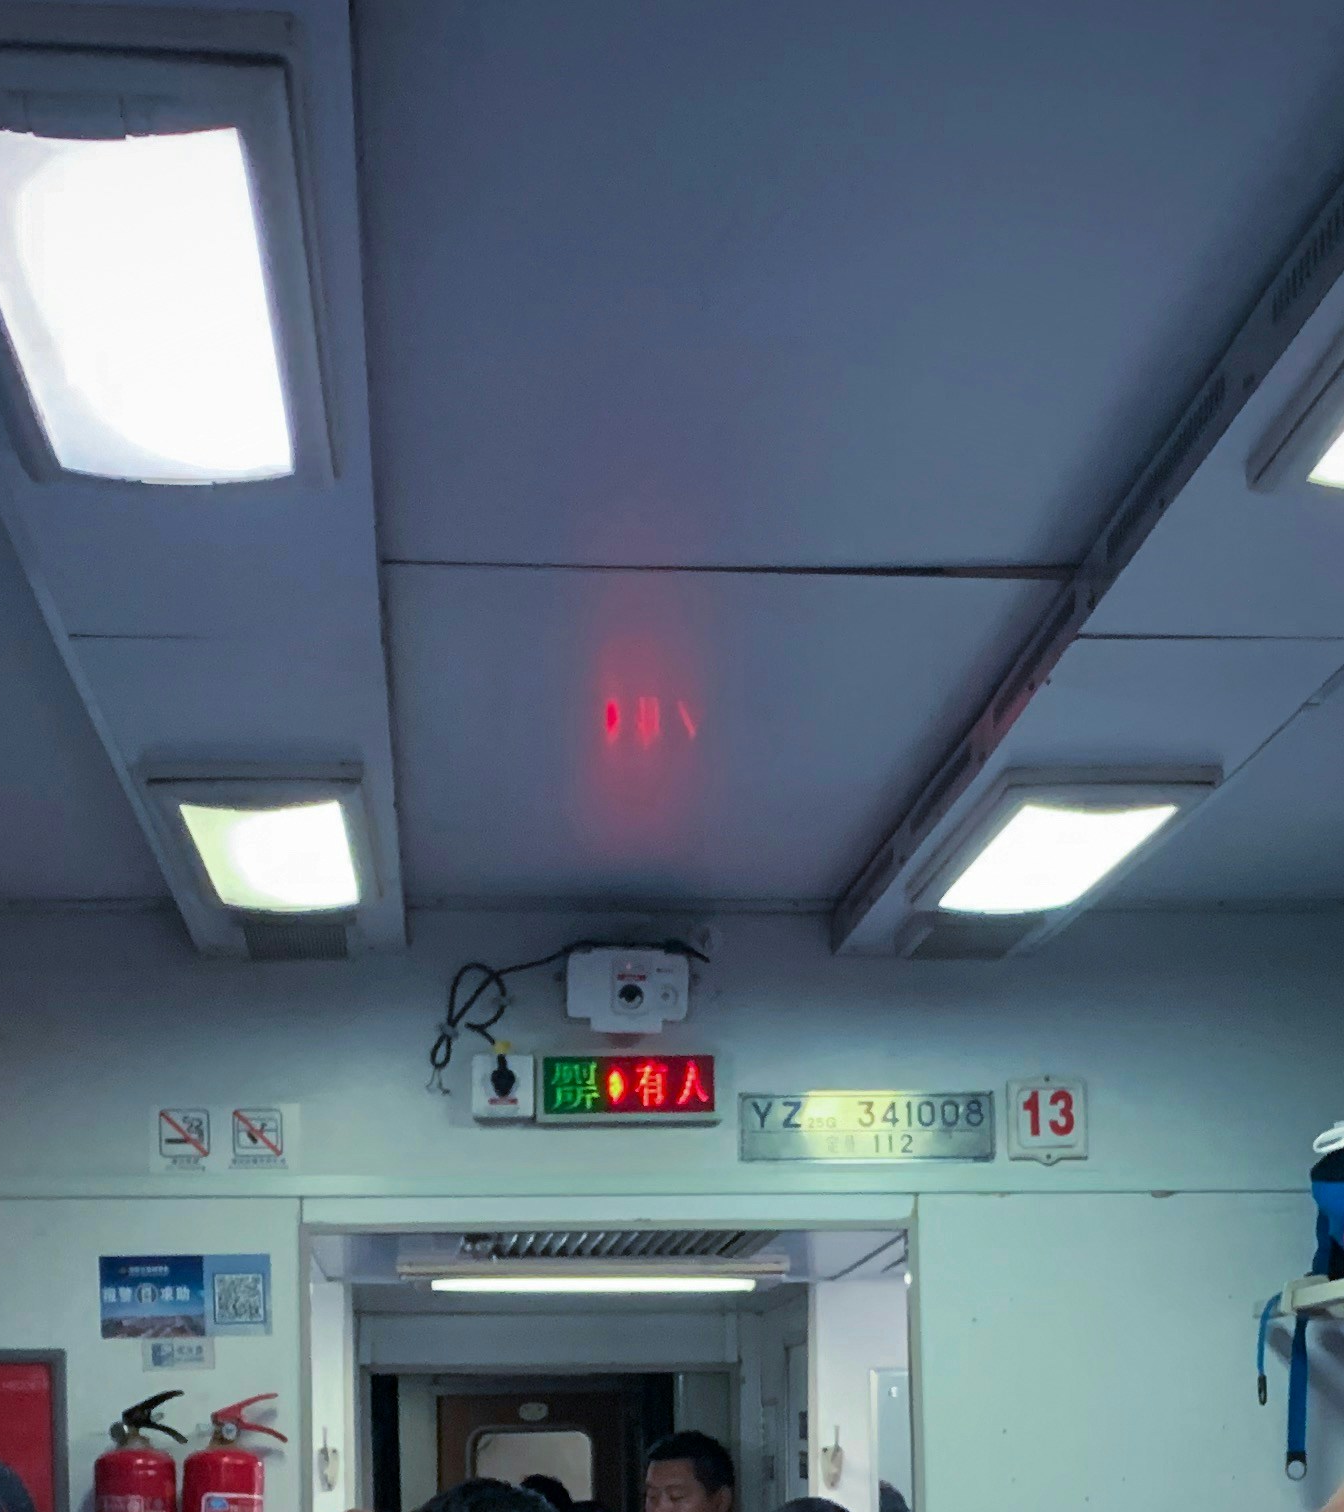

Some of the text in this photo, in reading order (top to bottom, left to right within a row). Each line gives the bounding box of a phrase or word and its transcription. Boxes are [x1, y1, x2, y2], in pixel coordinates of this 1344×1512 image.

[551, 1062, 600, 1110] 厕所
[635, 1060, 709, 1107] 有人
[751, 1100, 803, 1129] YZ
[858, 1099, 985, 1129] 341008
[1023, 1089, 1075, 1137] 13
[873, 1133, 915, 1154] 112
